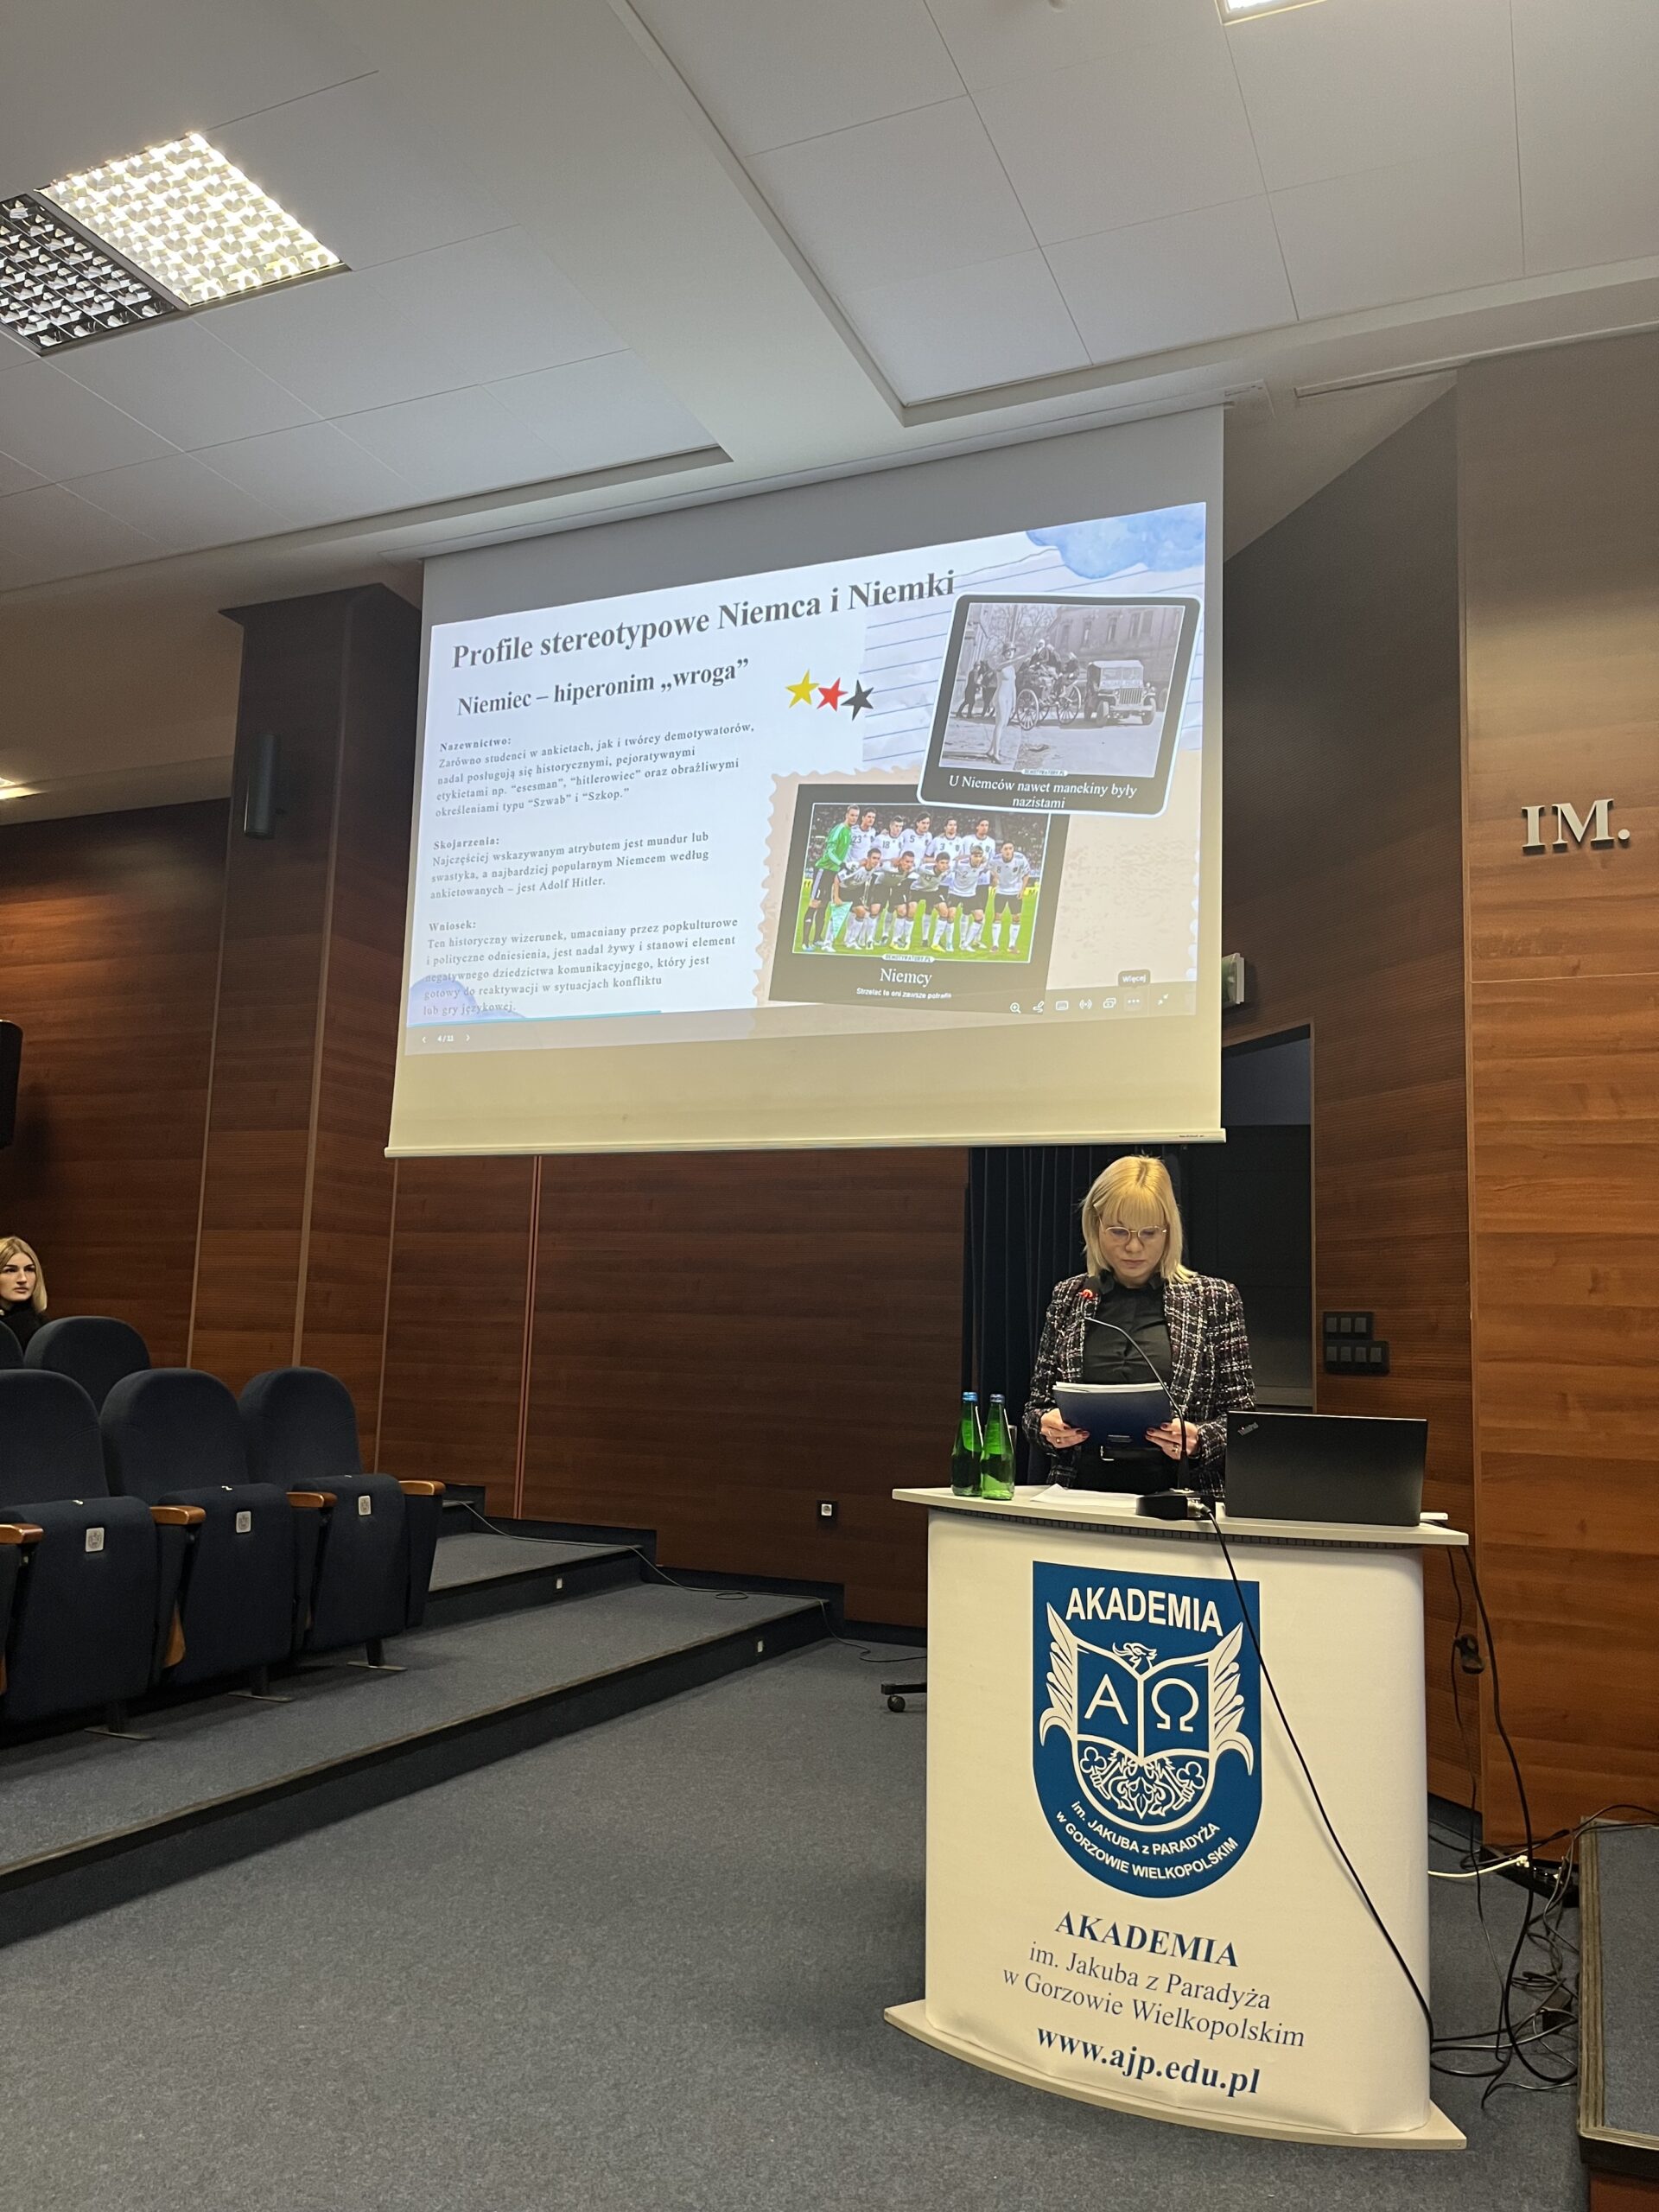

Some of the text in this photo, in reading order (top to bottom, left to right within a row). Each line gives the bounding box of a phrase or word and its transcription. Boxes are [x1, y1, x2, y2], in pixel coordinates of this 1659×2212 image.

[452, 569, 955, 669] Profile stereotypowe Niemca i Niemki
[457, 691, 531, 715] Niemiec
[554, 674, 654, 705] hiperonim
[661, 658, 748, 692] „wroga”
[439, 758, 481, 767] Zarówno
[485, 751, 526, 763] studenci
[542, 741, 593, 756] ankietach,
[596, 740, 613, 752] jak
[617, 738, 620, 747] i
[625, 734, 661, 746] twórcy
[664, 723, 754, 741] demotywatorów,
[440, 738, 512, 752] Nazewnictwo:
[436, 787, 488, 802] etykietami
[645, 768, 667, 778] oraz
[671, 758, 739, 775] obraźliwymi
[437, 747, 695, 785] nadal posługują się historycznymi, pejoratywnymi
[949, 775, 1137, 798] U Niemców nawet manekiny były
[1013, 797, 1065, 809] nazistami
[435, 803, 499, 817] określeniami
[503, 802, 524, 812] typu
[528, 794, 571, 808] “Szwab”
[575, 793, 578, 802] i
[1522, 798, 1630, 848] IM.
[433, 831, 709, 867] Najczęściej wskazywanym atrybutem jest mundur lub
[434, 836, 499, 850] Skojarzenia:
[431, 870, 479, 883] swastyka,
[492, 866, 548, 879] najbardziej
[551, 860, 613, 875] popularnym
[617, 855, 665, 867] Niemcem
[671, 849, 709, 861] według
[430, 885, 504, 899] ankietowanych
[517, 884, 535, 895] jest
[539, 879, 569, 891] Adolf
[572, 876, 606, 887] Hitler.
[428, 918, 738, 949] Ten historyczny wizerunek, umacniany przez popkulturowe
[429, 920, 476, 931] Wniosek:
[427, 936, 735, 967] i polityczne odniesienia, jest nadal żywy i stanowi element
[425, 956, 709, 983] negatywnego dziedzictwa komunikacyjnego, który jest
[880, 968, 932, 988] Niemcy
[424, 987, 461, 1001] gotowy
[464, 986, 474, 995] do
[479, 982, 538, 995] reaktywacji
[555, 978, 608, 994] sytuacjach
[613, 976, 662, 988] konfliktu
[423, 1006, 438, 1015] lub
[442, 1007, 458, 1016] gry
[1065, 1586, 1224, 1637] AKADEMIA
[1055, 1810, 1238, 1879] w GORZOWIE WIELKOPOLSKIM
[1071, 1801, 1220, 1856] im. JAKUBA z PARADYŻA
[1054, 1910, 1238, 1967] AKADEMIA
[1029, 1941, 1271, 2011] im. Jakuba z Paradyża
[1002, 1969, 1305, 2047] w Gorzowie Wielkopolskim
[1036, 2027, 1261, 2098] www.ajp.edu.pl
